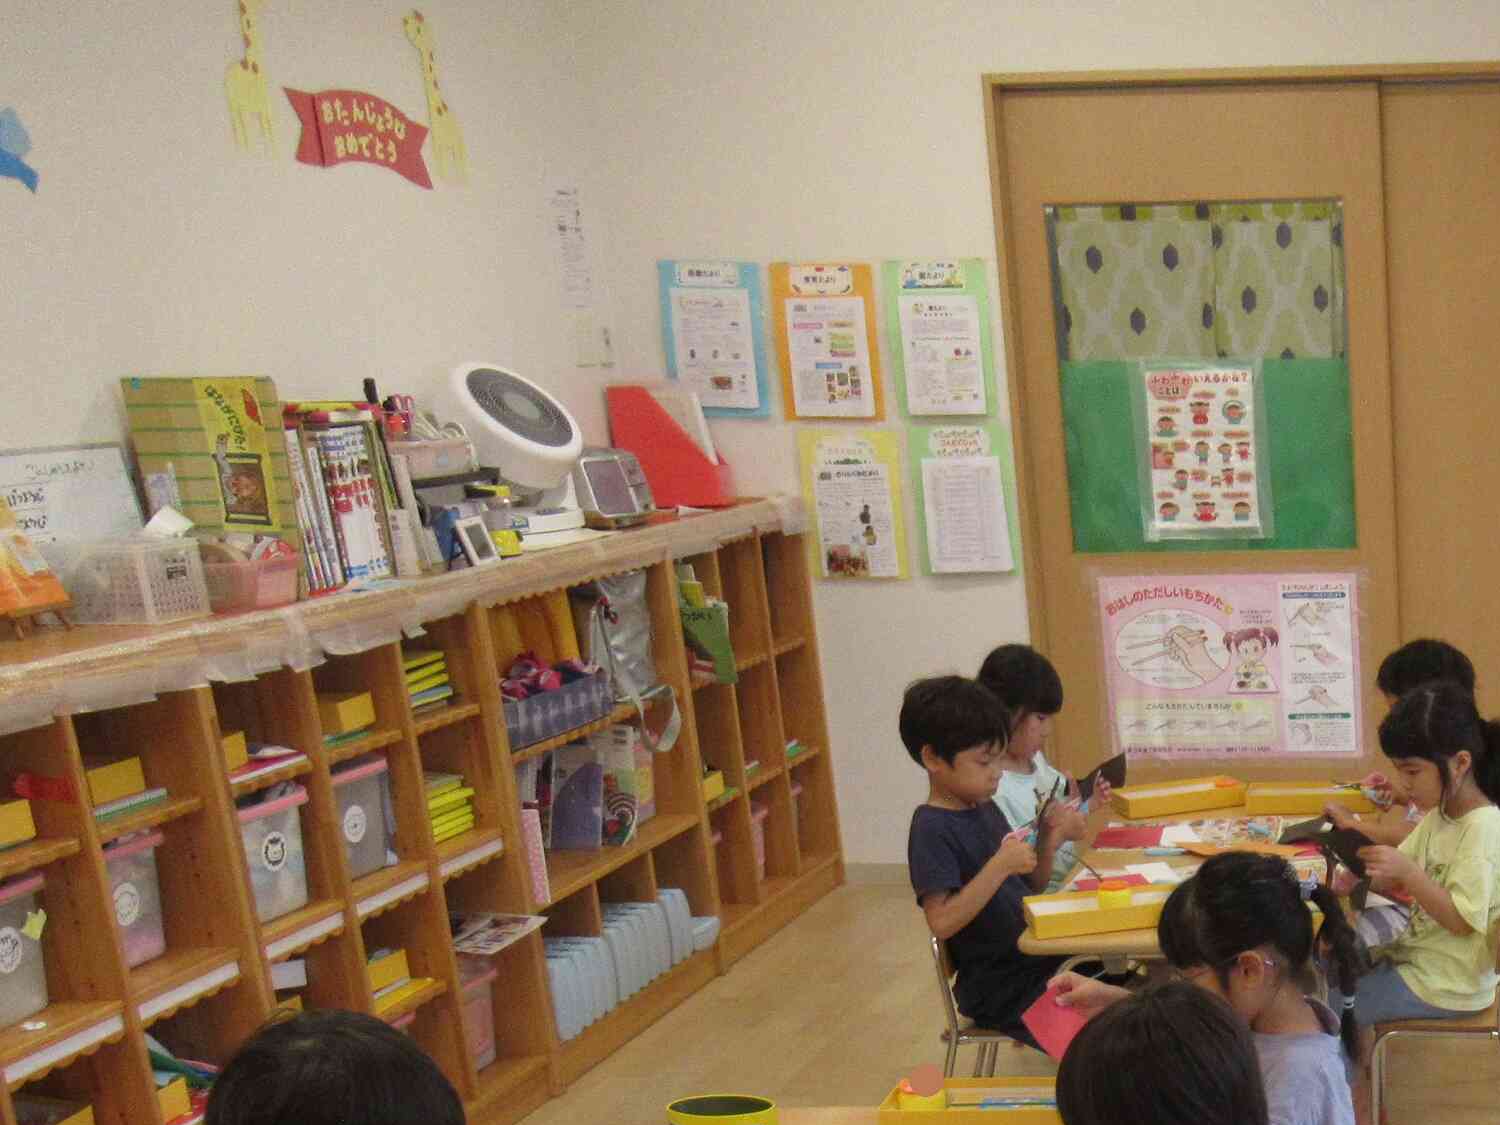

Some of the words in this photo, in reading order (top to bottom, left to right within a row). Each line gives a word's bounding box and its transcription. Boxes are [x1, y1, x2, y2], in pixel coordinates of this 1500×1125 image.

[321, 98, 406, 140] おたんじょうび
[334, 132, 398, 163] おめでとう
[1105, 583, 1225, 617] おはしのただしいもちかた
